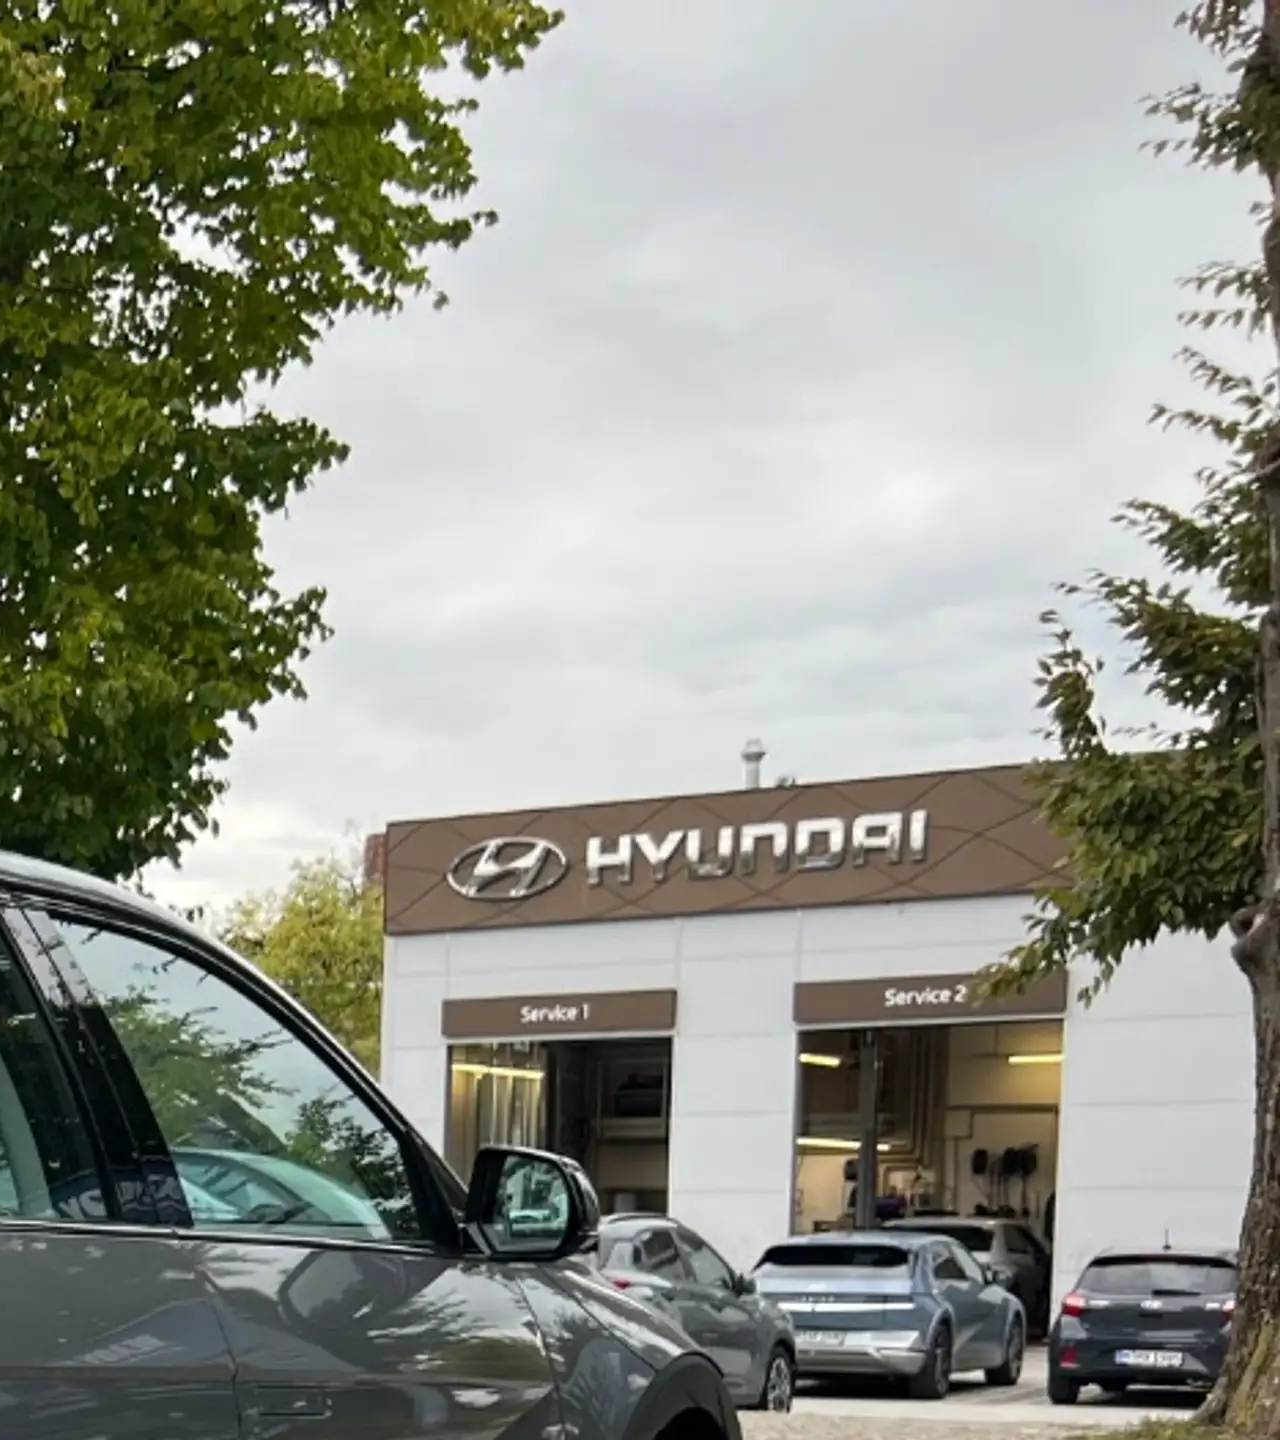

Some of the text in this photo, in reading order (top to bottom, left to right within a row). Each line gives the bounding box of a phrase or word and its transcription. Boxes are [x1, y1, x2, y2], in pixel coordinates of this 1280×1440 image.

[585, 809, 928, 888] HYUNDAI
[883, 984, 968, 1008] Service 2
[520, 1003, 578, 1024] Service
